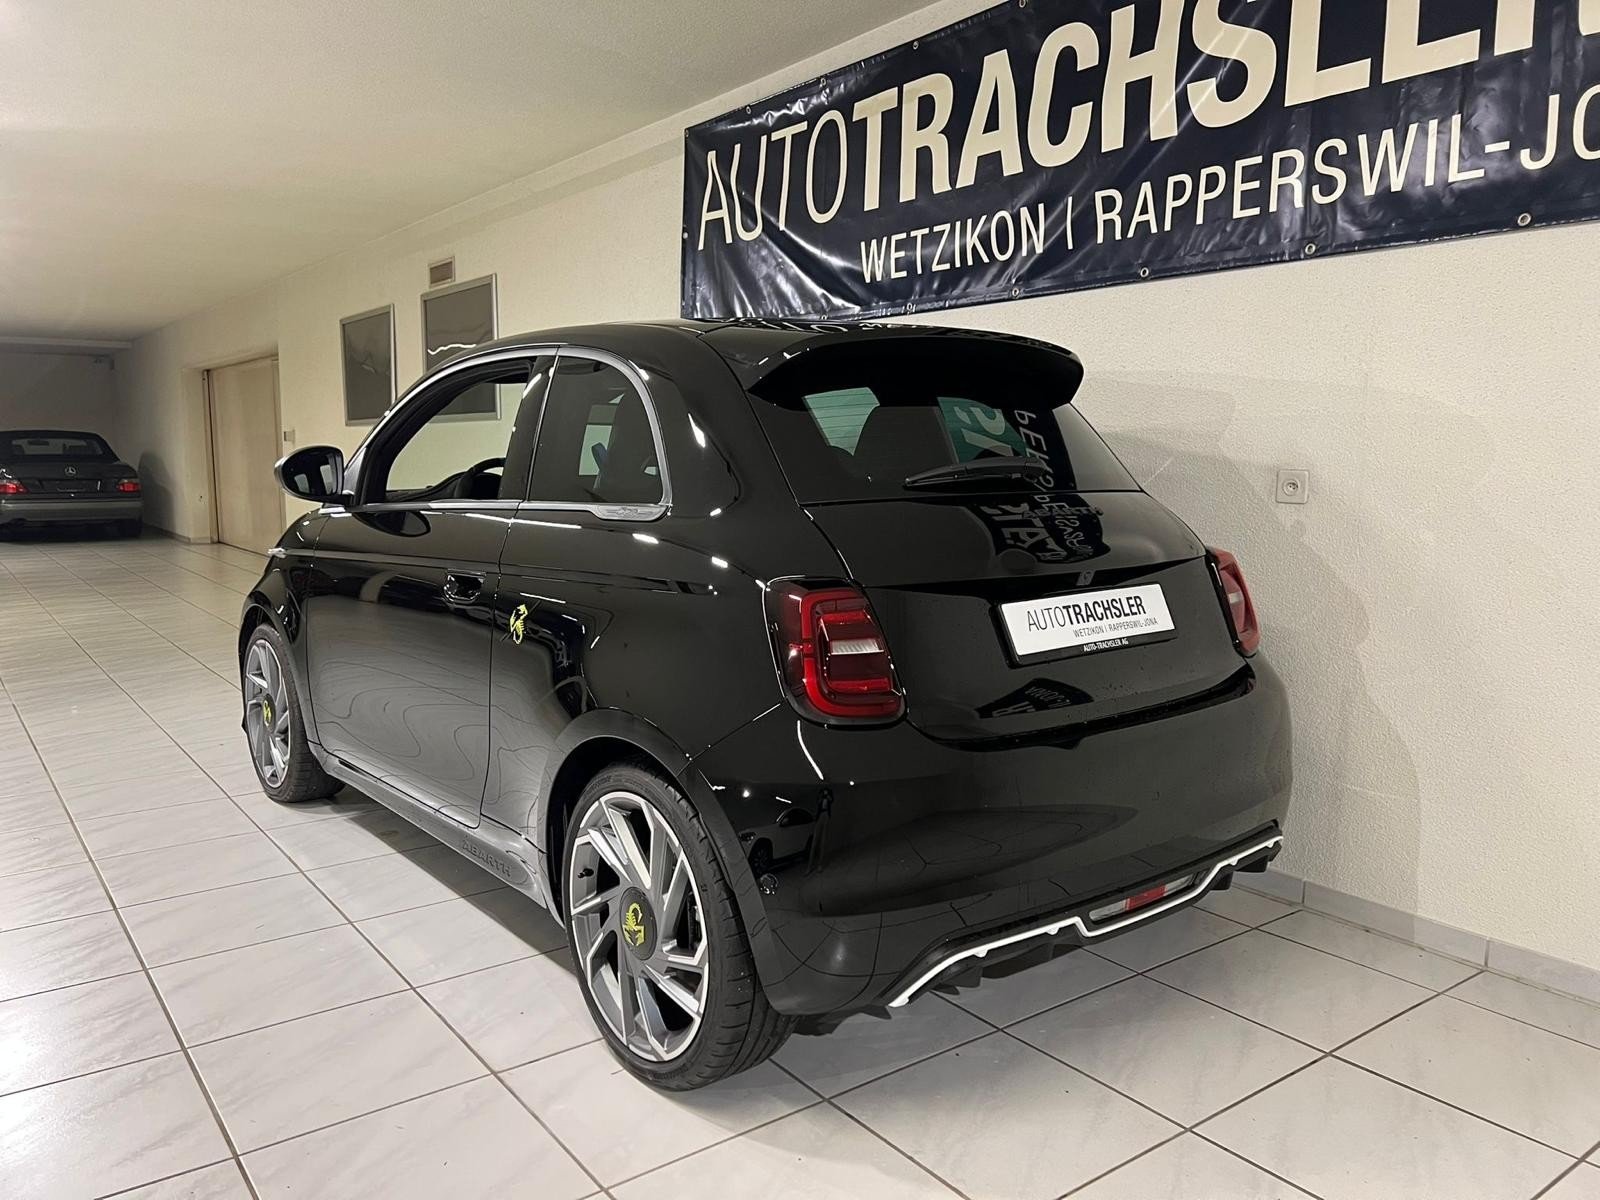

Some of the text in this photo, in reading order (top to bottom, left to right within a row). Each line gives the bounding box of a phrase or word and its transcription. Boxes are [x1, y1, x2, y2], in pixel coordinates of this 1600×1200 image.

[861, 206, 1045, 283] WETZIKON
[1027, 595, 1147, 632] AUTOTRACHSLER
[1073, 624, 1104, 638] WETZIKON
